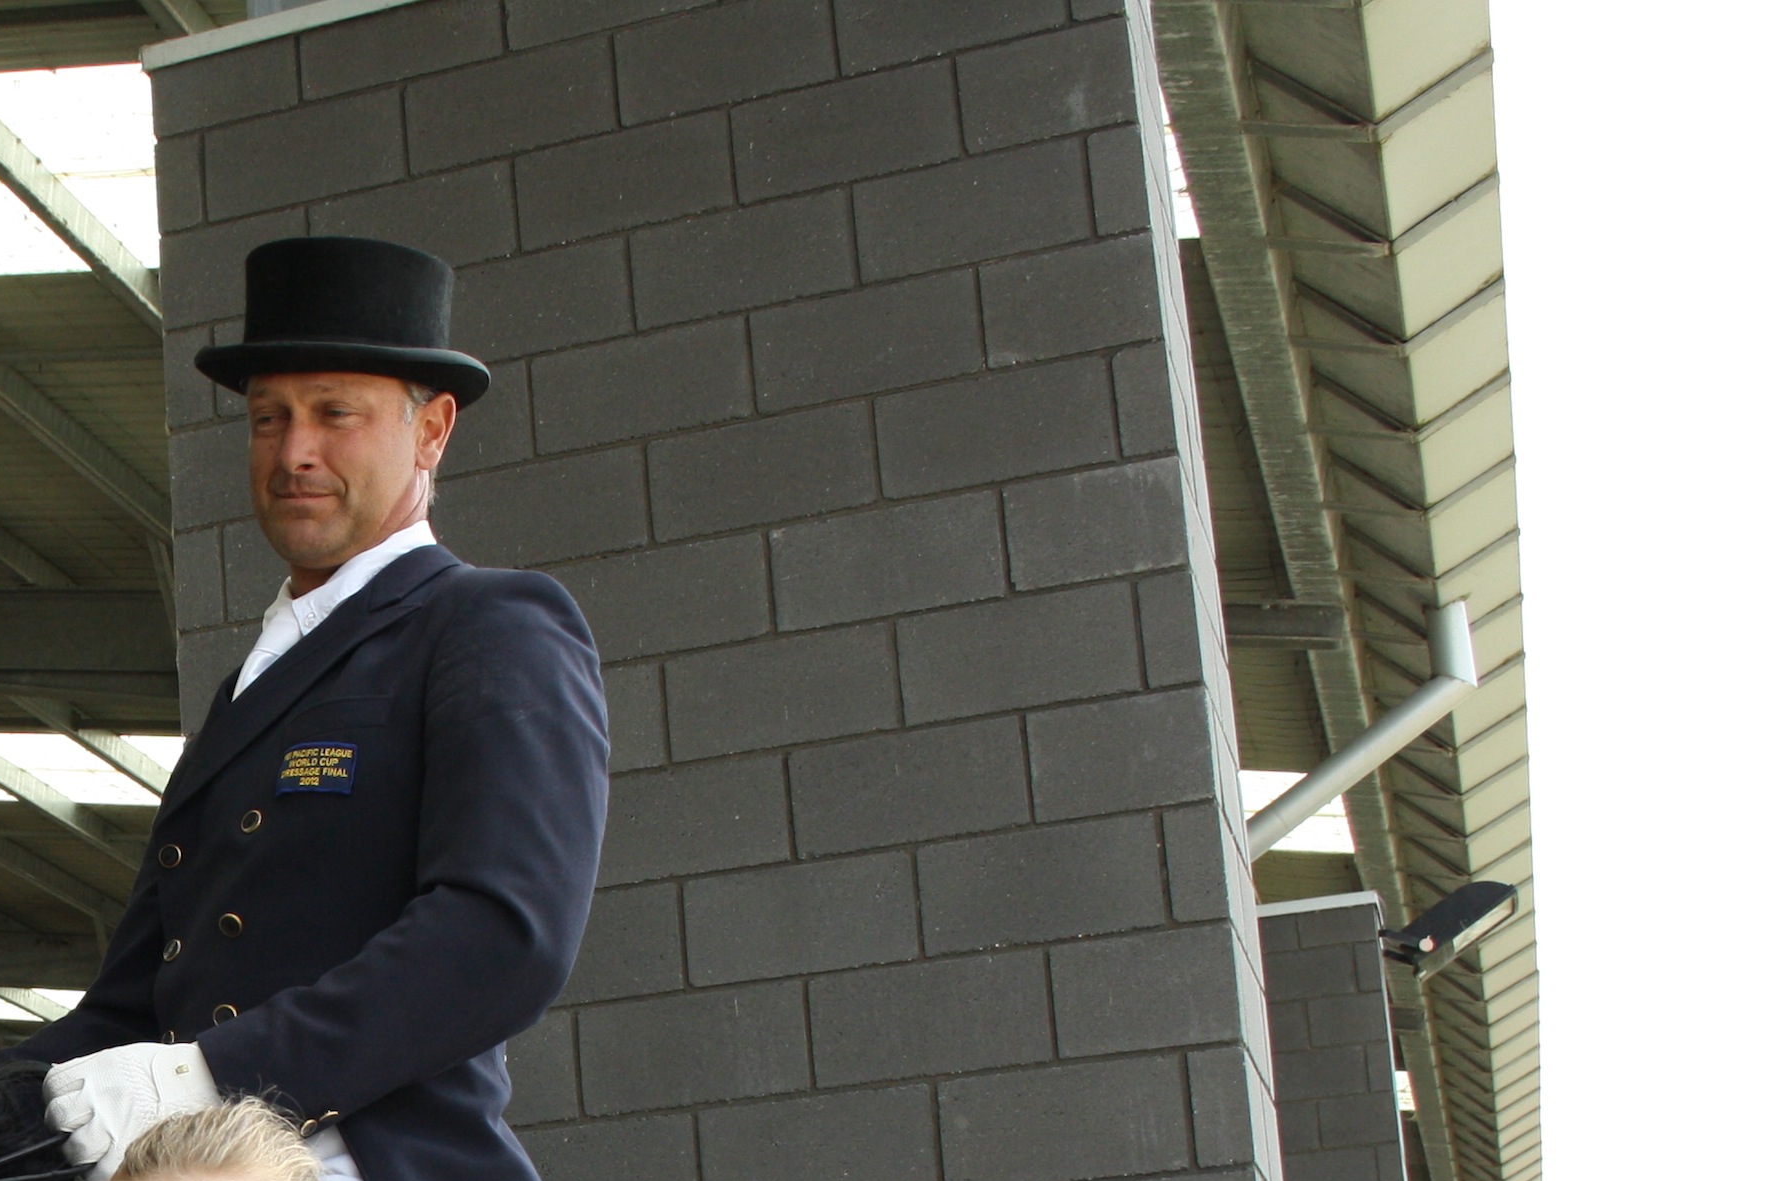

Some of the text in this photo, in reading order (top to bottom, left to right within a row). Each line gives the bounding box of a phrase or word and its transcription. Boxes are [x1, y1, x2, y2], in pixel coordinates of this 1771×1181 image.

[292, 748, 318, 758] PACIFIC
[320, 748, 353, 758] LEAGUE
[289, 757, 339, 767] WORLD CUP
[322, 768, 348, 777] FINAL
[299, 776, 319, 786] 2012
